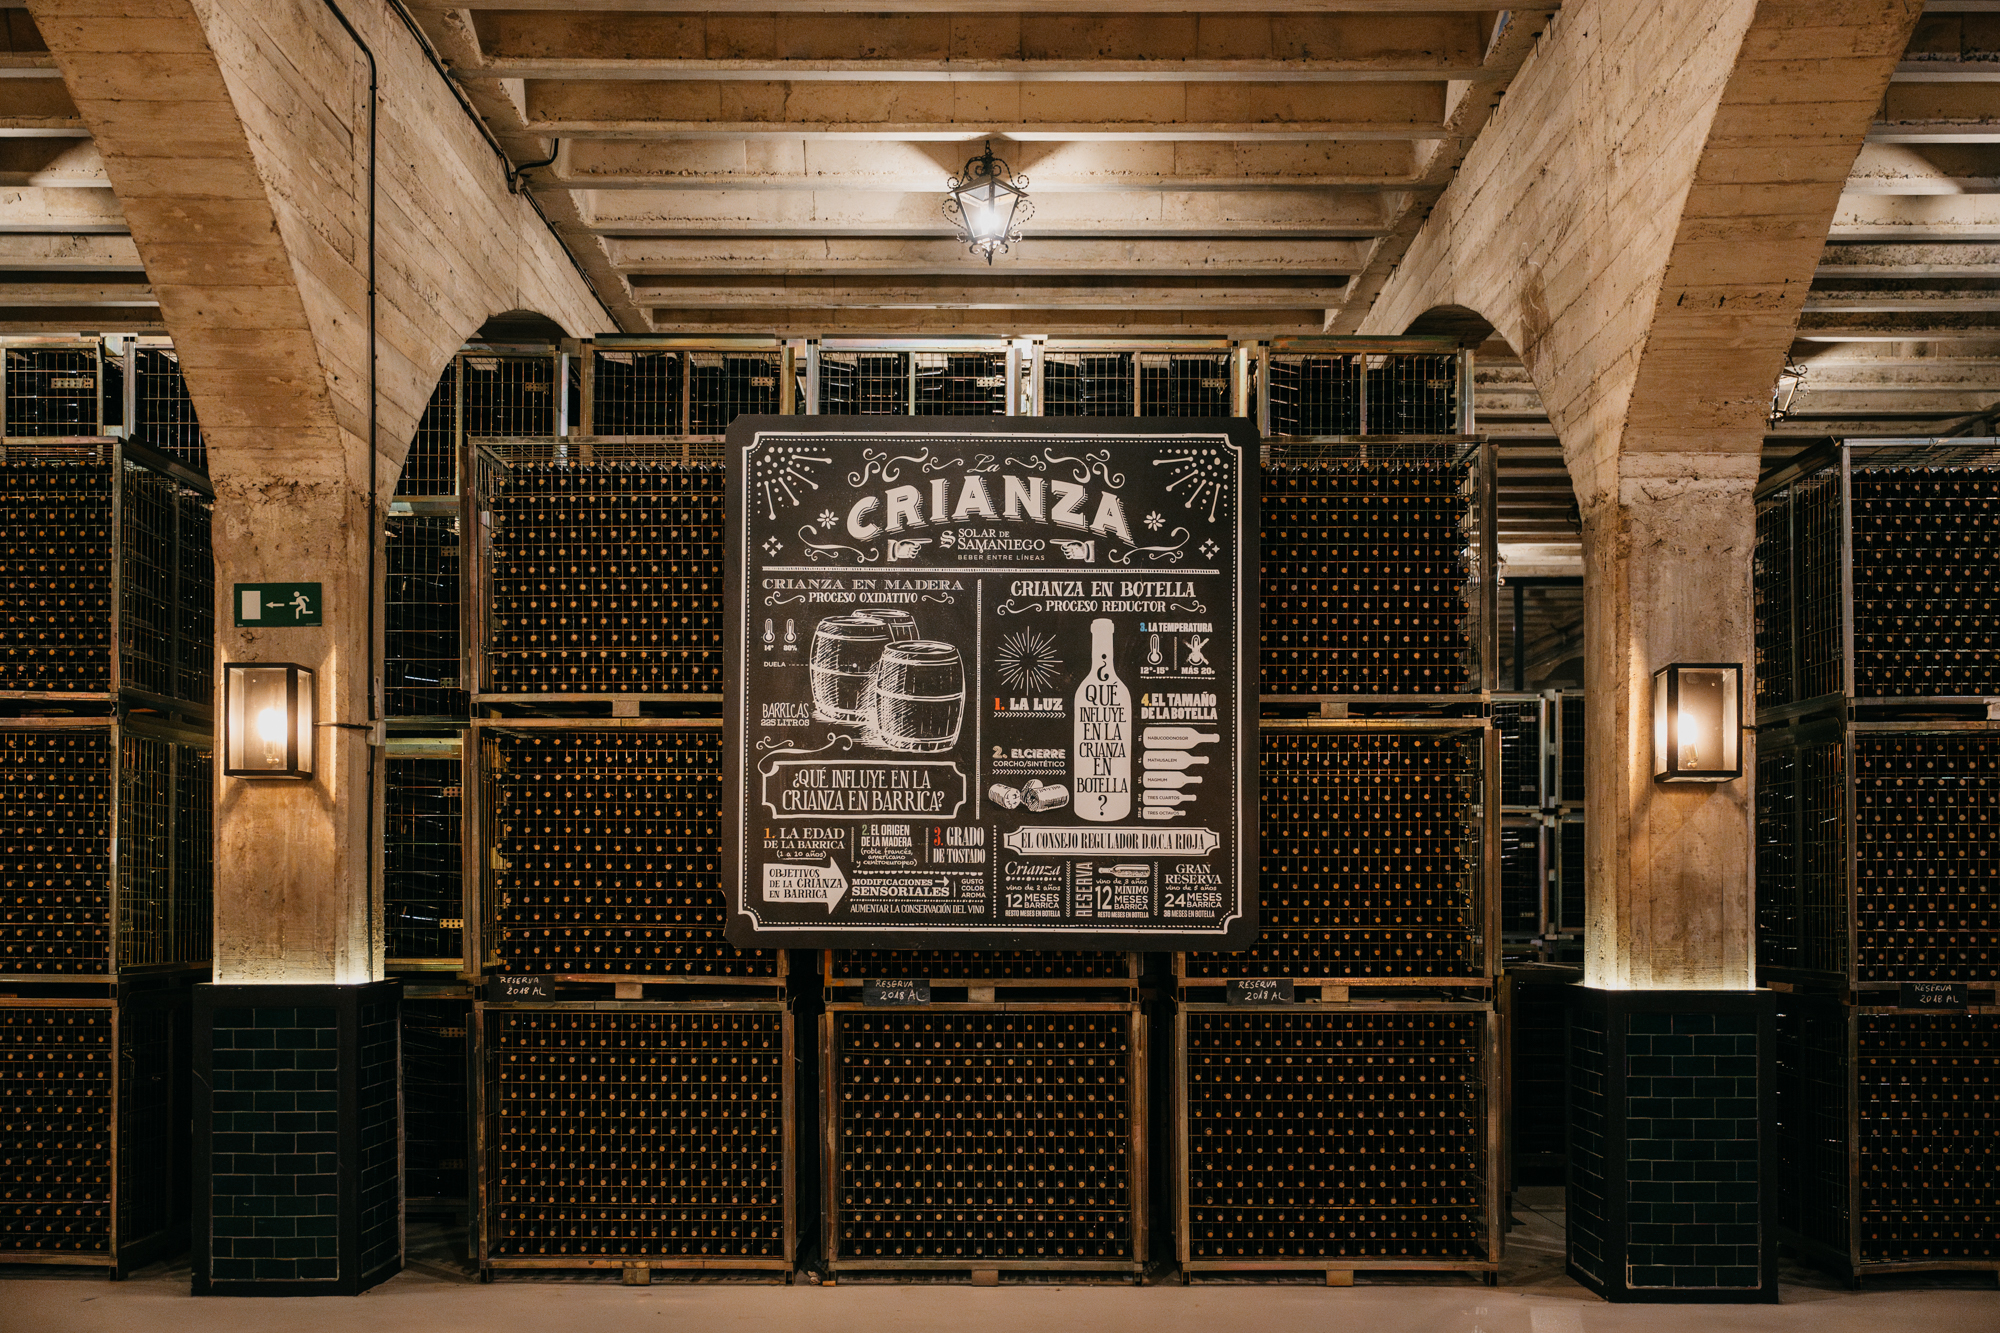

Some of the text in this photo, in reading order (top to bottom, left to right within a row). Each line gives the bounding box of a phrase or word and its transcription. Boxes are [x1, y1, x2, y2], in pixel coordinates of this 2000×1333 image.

[967, 454, 1000, 473] La
[847, 475, 1137, 547] CRIANZA
[958, 528, 995, 538] SOLAR
[957, 538, 1045, 552] SAMANIEGO
[762, 579, 964, 590] CRIANZA EN MADERA
[1011, 581, 1196, 597] CRIANZA EN BOTELLA
[809, 592, 918, 602] PROCESO OXIDATIVO
[1046, 601, 1165, 612] PROCESO REDUCTOR
[1140, 623, 1212, 632] 3. LA TEMPERATURA
[1181, 666, 1199, 674] MÁS
[1086, 682, 1120, 706] QUÉ
[1167, 692, 1216, 706] TAMAÑO
[995, 698, 1063, 710] 1. LA LUZ
[762, 702, 809, 718] BARRICAS
[1080, 708, 1126, 722] INFLUYE
[1171, 708, 1217, 720] BOTELLA
[1084, 723, 1122, 740] EN LA
[993, 746, 1007, 758] 2.
[1079, 742, 1126, 757] CRIANZA
[1094, 758, 1111, 775] EN
[792, 767, 931, 788] ¿QUÉ INFLUYE EN LA
[1077, 778, 1128, 793] BOTELLA
[782, 790, 945, 811] CRIANZA EN BARRICA?
[764, 828, 844, 839] 1. LA EDAD
[862, 825, 910, 835] 2. EL ORIGEN
[861, 837, 912, 846] DE LA MADERA
[933, 826, 984, 846] 3. GRADO
[1021, 833, 1033, 848] EL
[1036, 833, 1076, 848] CONSEJO
[1081, 834, 1139, 848] REGULADOR
[1175, 834, 1204, 849] RIOJA
[764, 840, 845, 849] DE LA BARRICA
[805, 850, 826, 858] años)
[860, 848, 881, 856] (roble
[933, 848, 985, 864] DE TOSTADO
[769, 869, 820, 877] OBJETIVOS
[1005, 861, 1061, 876] Crianza
[1176, 864, 1210, 874] GRAN
[797, 878, 843, 888] CRIANZA
[852, 878, 933, 886] MODIFICACIONES
[1165, 874, 1222, 885] RESERVA
[784, 889, 828, 898] BARRICA
[852, 887, 949, 896] SENSORIALES
[1075, 862, 1092, 916] RESERVA
[1115, 884, 1148, 894] MÍNIMO
[1006, 894, 1022, 907] 12
[1095, 886, 1112, 909] 12
[1115, 895, 1148, 903] MESES
[1165, 894, 1186, 907] 24
[1187, 893, 1222, 901] MESES
[850, 903, 984, 913] AUMENTAR LA CONSERVACIÓN DEL VINO
[1171, 910, 1187, 918] MESES
[1188, 910, 1194, 918] EN
[1195, 910, 1215, 918] BOTELLA
[500, 976, 539, 984] RESERVA
[875, 980, 914, 988] RESERVA
[1238, 981, 1277, 989] RESERVA
[506, 987, 546, 996] 2018 AL
[880, 990, 927, 1001] 2018 AL
[1245, 991, 1289, 1001] 2018 AL
[1920, 995, 1959, 1003] 2018 AL
